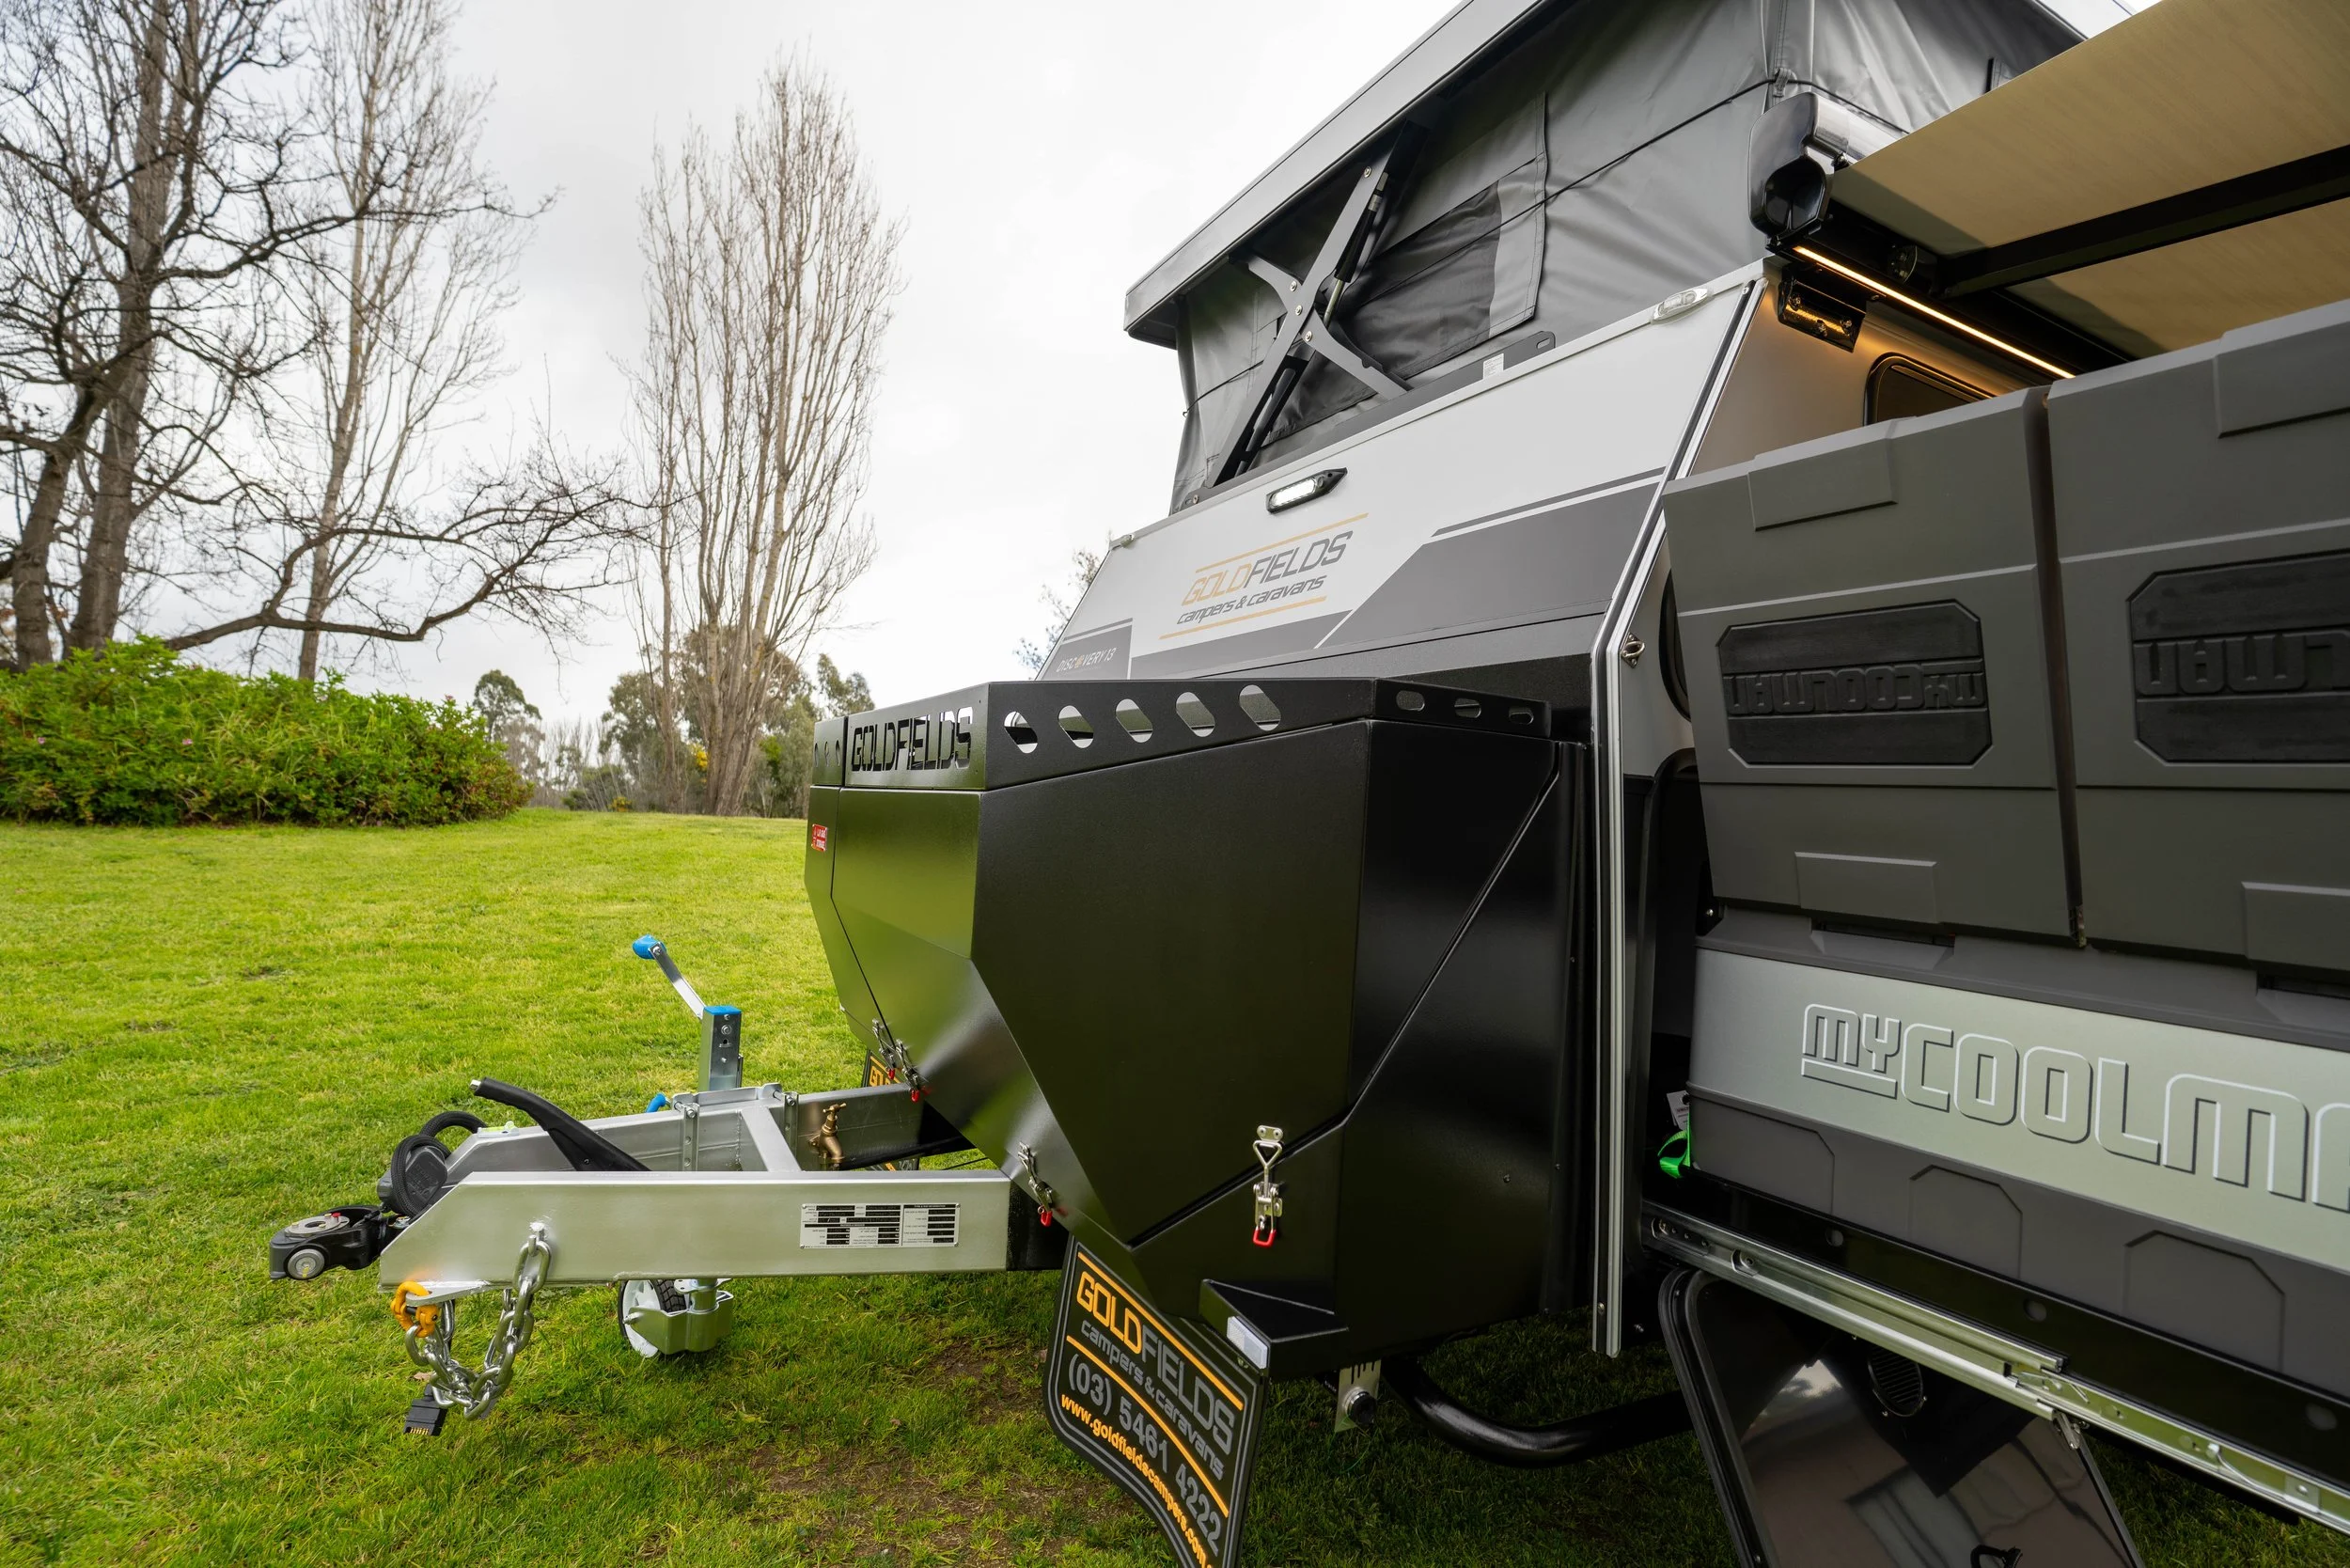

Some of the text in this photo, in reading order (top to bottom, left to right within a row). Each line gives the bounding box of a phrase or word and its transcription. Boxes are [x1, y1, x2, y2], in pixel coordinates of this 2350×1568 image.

[1177, 574, 1327, 624] campers & caravans
[1182, 530, 1354, 606] GOLDFIELDS
[1104, 647, 1117, 662] 13
[852, 706, 974, 772] GOLDFIELDS
[1076, 1271, 1235, 1455] GOLDFIELDS
[1081, 1319, 1225, 1482] campers & caravans
[1060, 1393, 1214, 1568] www.goldfieldscampers.com
[1068, 1354, 1221, 1558] (03) 5461 4222
